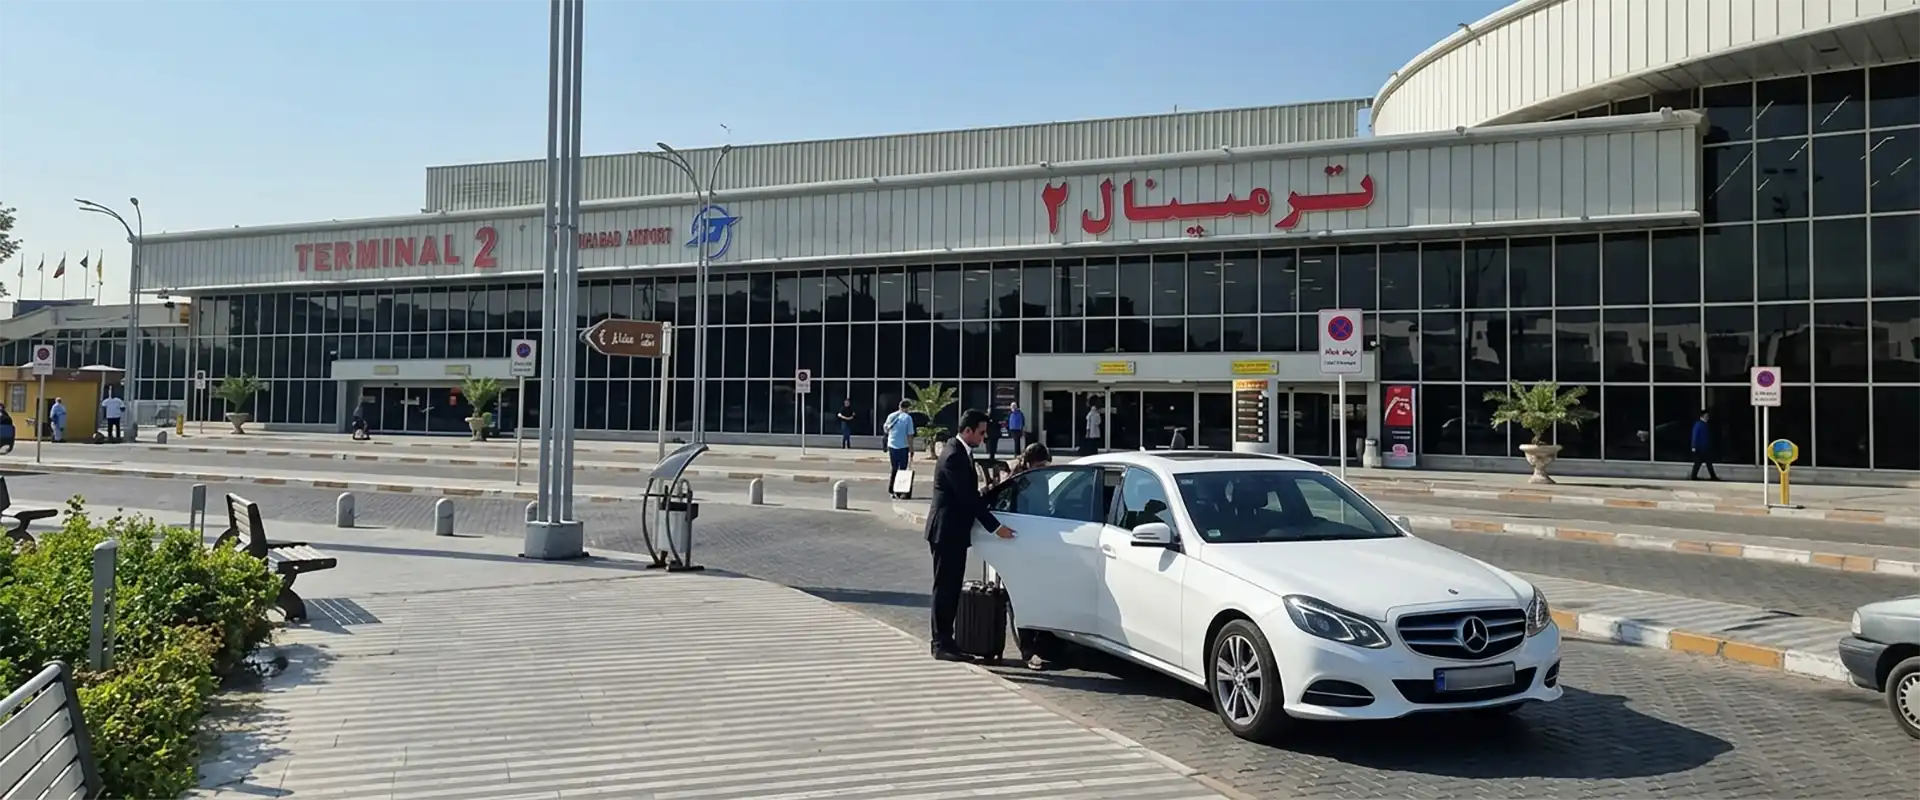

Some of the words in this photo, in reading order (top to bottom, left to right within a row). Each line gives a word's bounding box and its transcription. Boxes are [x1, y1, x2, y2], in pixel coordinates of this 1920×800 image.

[1041, 181, 1068, 235] ۲
[1082, 164, 1375, 237] ترمینال
[294, 234, 462, 273] TERMINAL
[473, 225, 499, 268] 2
[626, 226, 672, 246] AIRPORT
